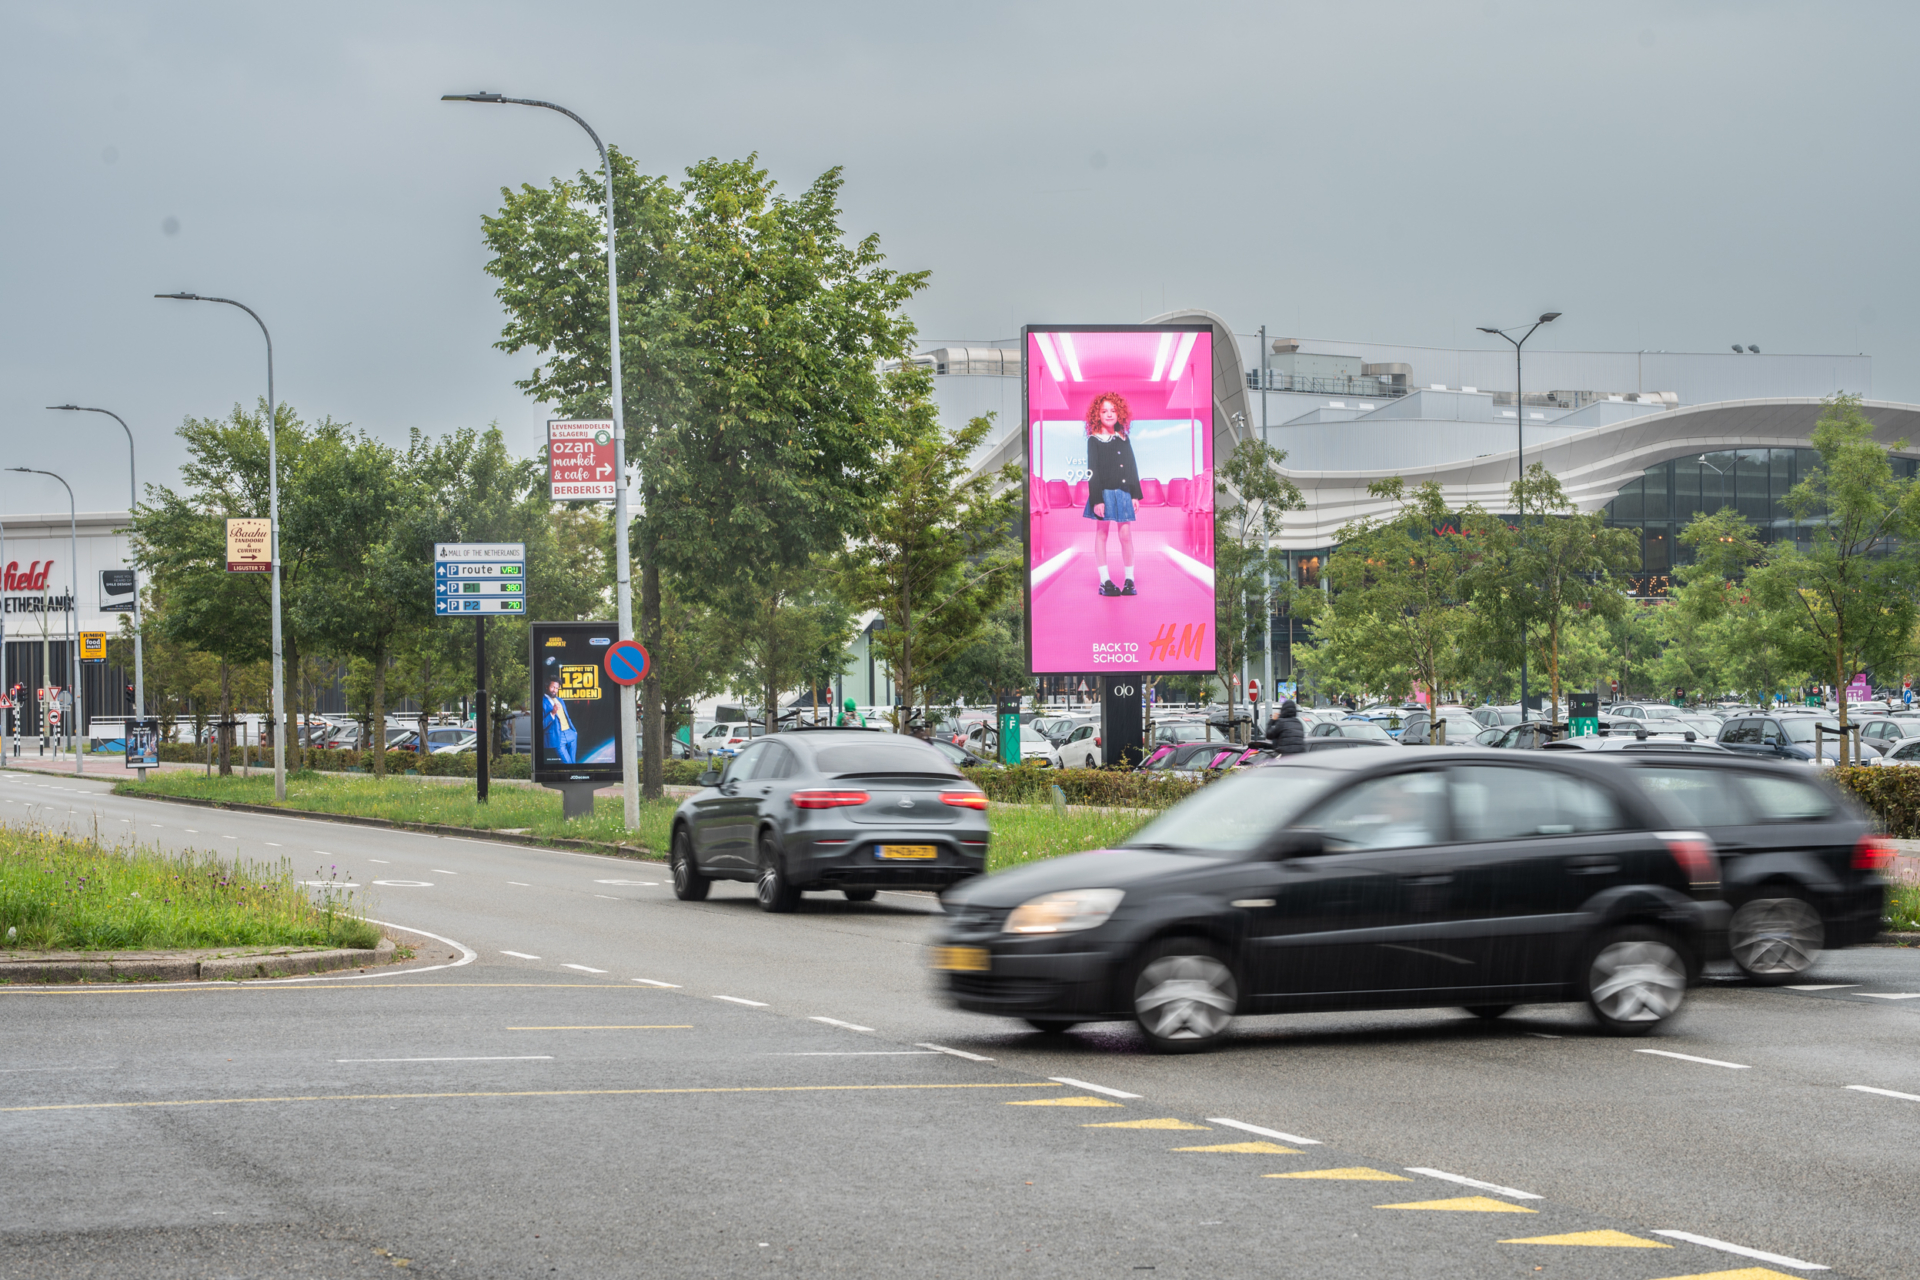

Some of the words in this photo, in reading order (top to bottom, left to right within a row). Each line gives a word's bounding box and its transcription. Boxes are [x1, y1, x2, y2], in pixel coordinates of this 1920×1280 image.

[553, 442, 594, 453] ozan
[553, 453, 596, 466] market
[1066, 456, 1086, 465] Vest
[554, 470, 562, 480] &
[564, 468, 590, 481] cafe
[554, 486, 600, 494] BERBERIS
[603, 486, 614, 494] 13
[230, 527, 268, 537] Baahu
[462, 565, 493, 574] route
[0, 560, 54, 591] field
[464, 584, 476, 592] P1
[464, 601, 479, 610] P2
[1149, 623, 1206, 662] H&M
[1093, 643, 1121, 652] BACK
[1124, 643, 1138, 652] TO
[1093, 654, 1138, 663] SCHOOL
[562, 673, 593, 688] 120
[559, 689, 597, 698] MILJOEN
[1010, 720, 1016, 729] F
[1584, 726, 1593, 736] H
